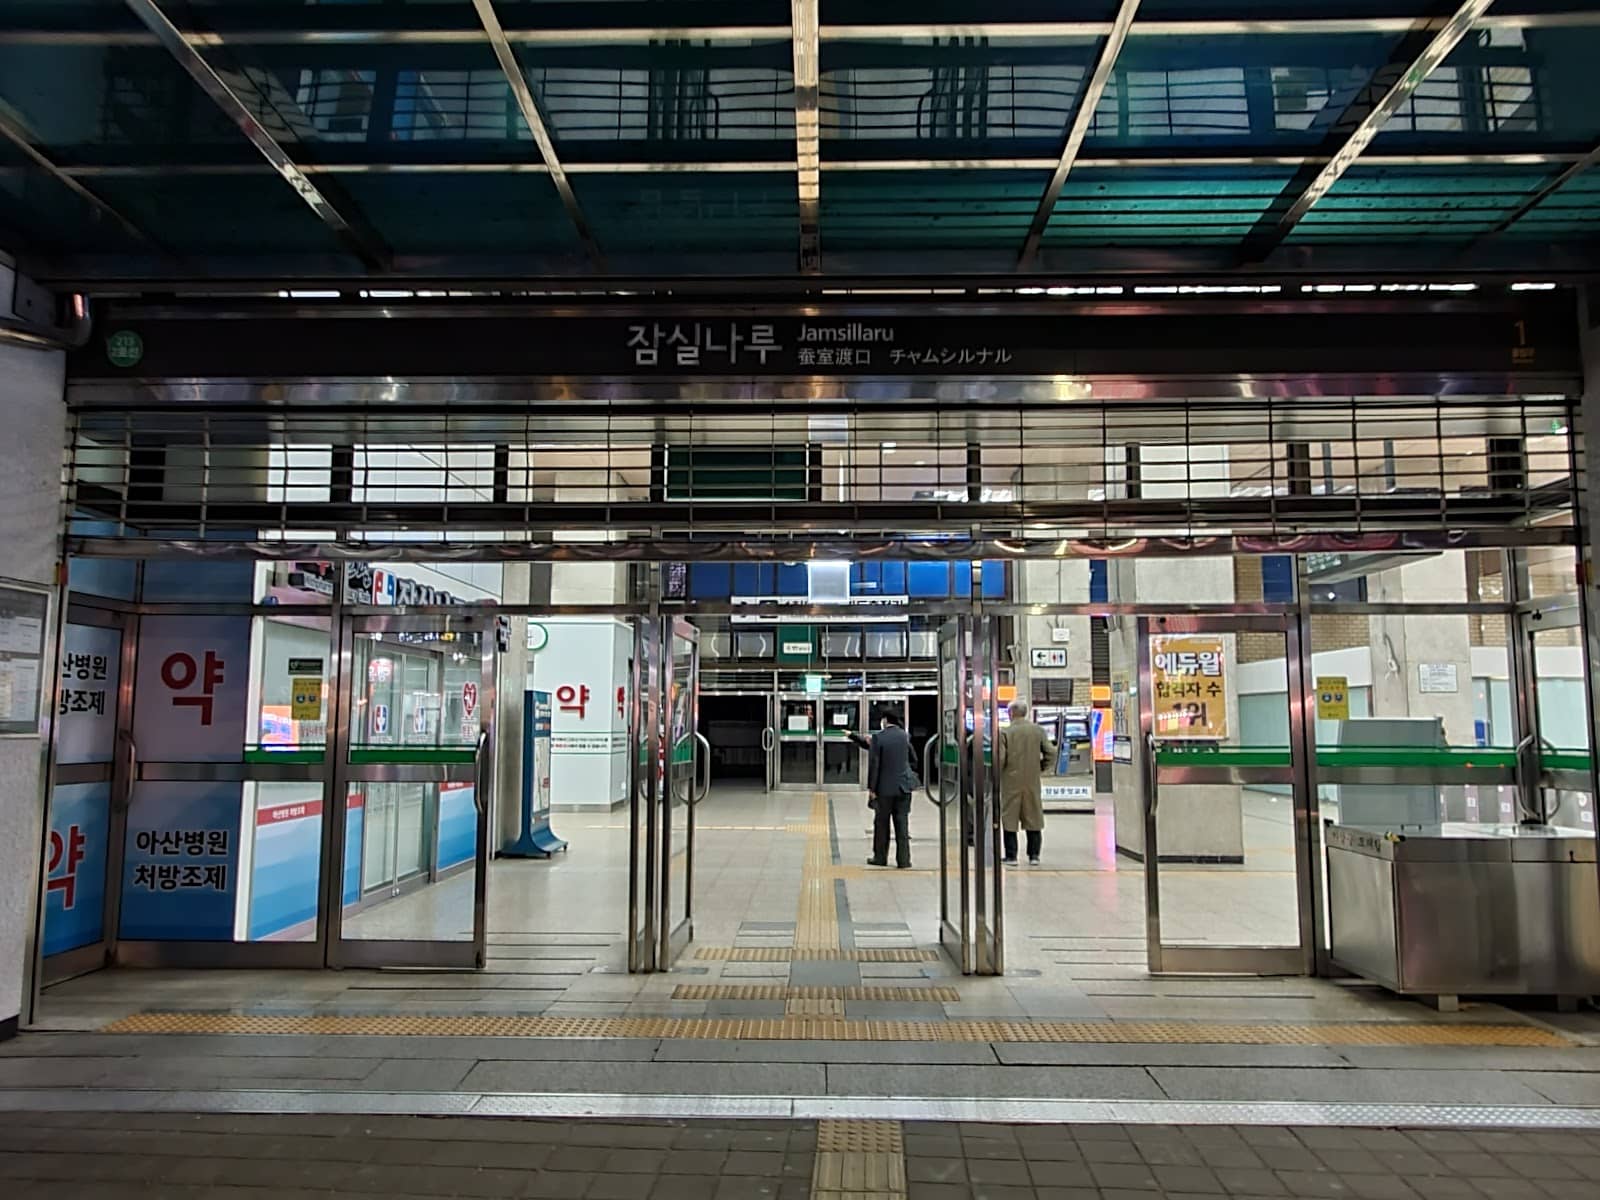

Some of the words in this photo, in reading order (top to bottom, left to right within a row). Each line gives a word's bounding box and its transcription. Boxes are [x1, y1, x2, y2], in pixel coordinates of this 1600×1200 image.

[626, 322, 783, 366] 잠실나루
[797, 323, 895, 342] Jamsillaru
[1513, 319, 1527, 346] 1
[798, 347, 871, 366] 蚕室渡口
[889, 347, 1013, 365] チャムシルナル
[1155, 652, 1222, 677] 에듀윌
[161, 650, 225, 726] 약
[1206, 681, 1222, 697] 수
[556, 684, 590, 721] 약
[136, 830, 228, 856] 아산병원
[47, 825, 86, 909] 약
[134, 864, 227, 891] 처방조제
